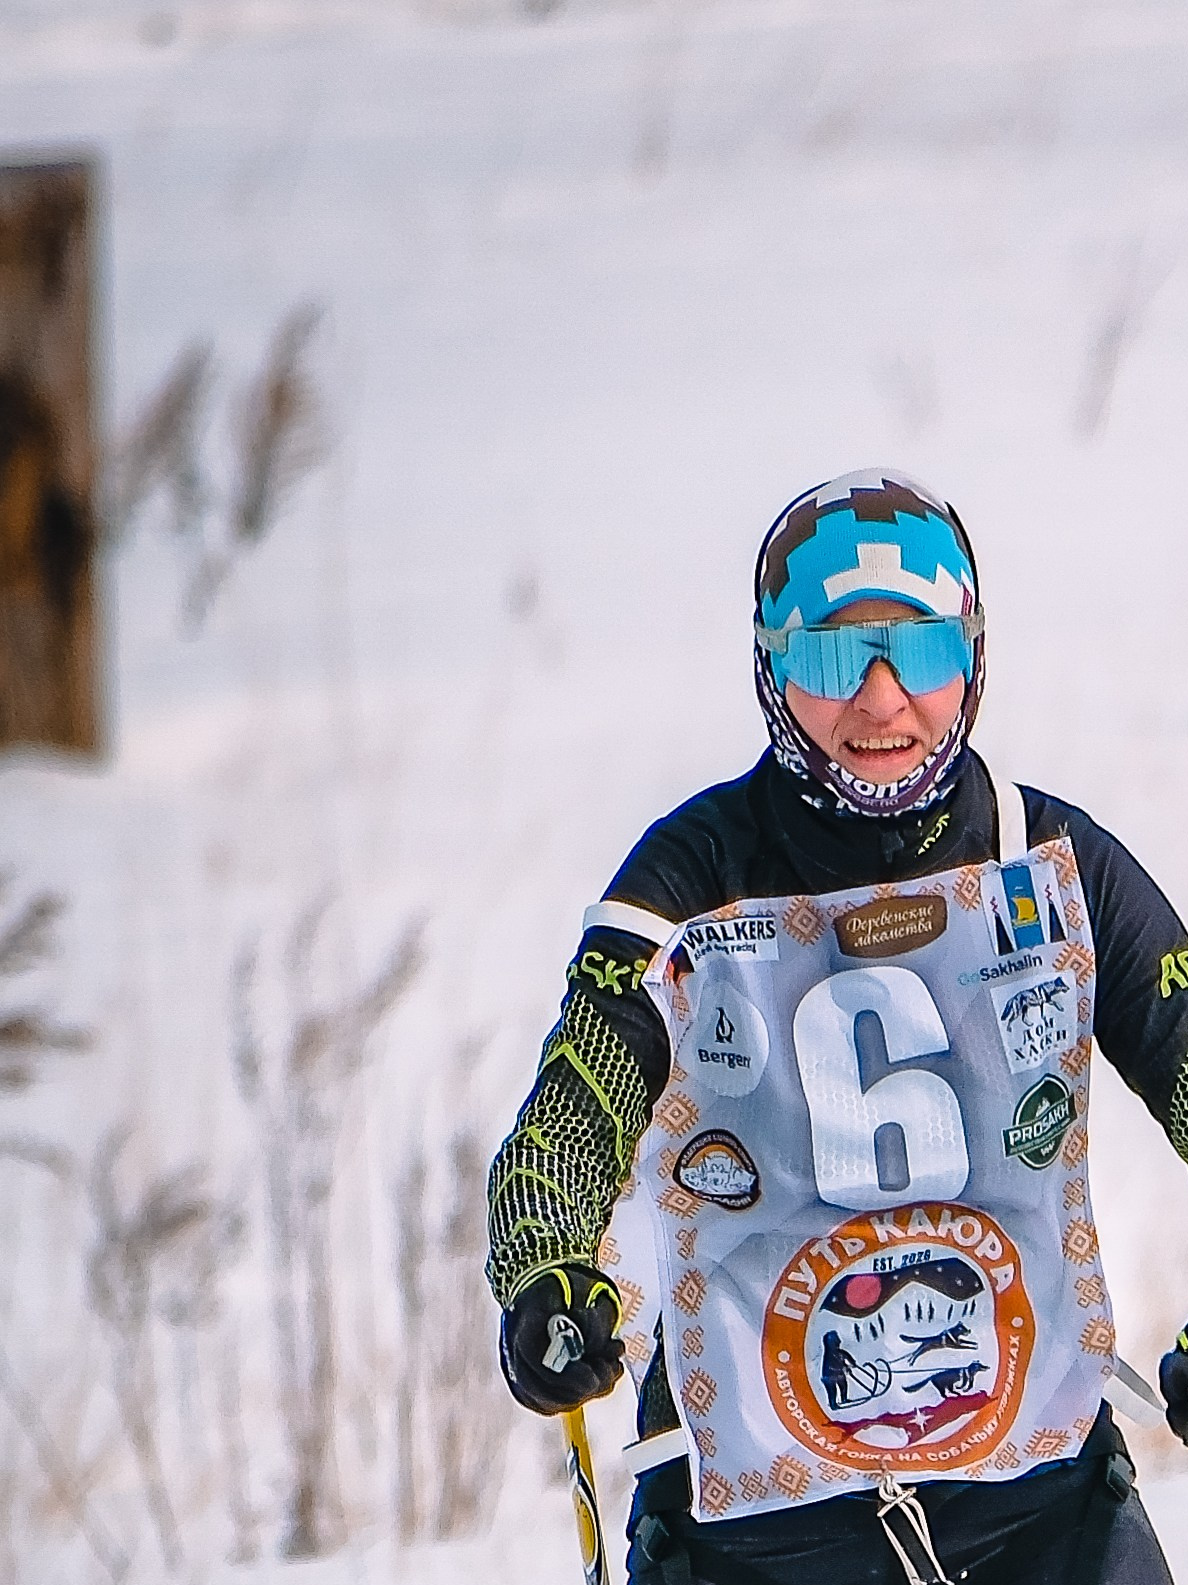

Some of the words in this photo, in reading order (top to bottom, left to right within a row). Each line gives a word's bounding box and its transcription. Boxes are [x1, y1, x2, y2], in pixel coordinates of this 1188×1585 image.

[683, 919, 777, 951] WALKERS
[846, 905, 934, 936] Деревенские
[1023, 1017, 1055, 1045] ДОМ
[698, 1048, 751, 1070] Bergen
[793, 965, 970, 1211] 6
[1008, 1103, 1069, 1147] PROSAKH
[773, 1236, 866, 1321] ПУТЬ
[869, 1208, 1015, 1294] КАЮРА
[775, 1367, 838, 1454] АВТОРСКАЯ
[899, 1452, 922, 1461] НА
